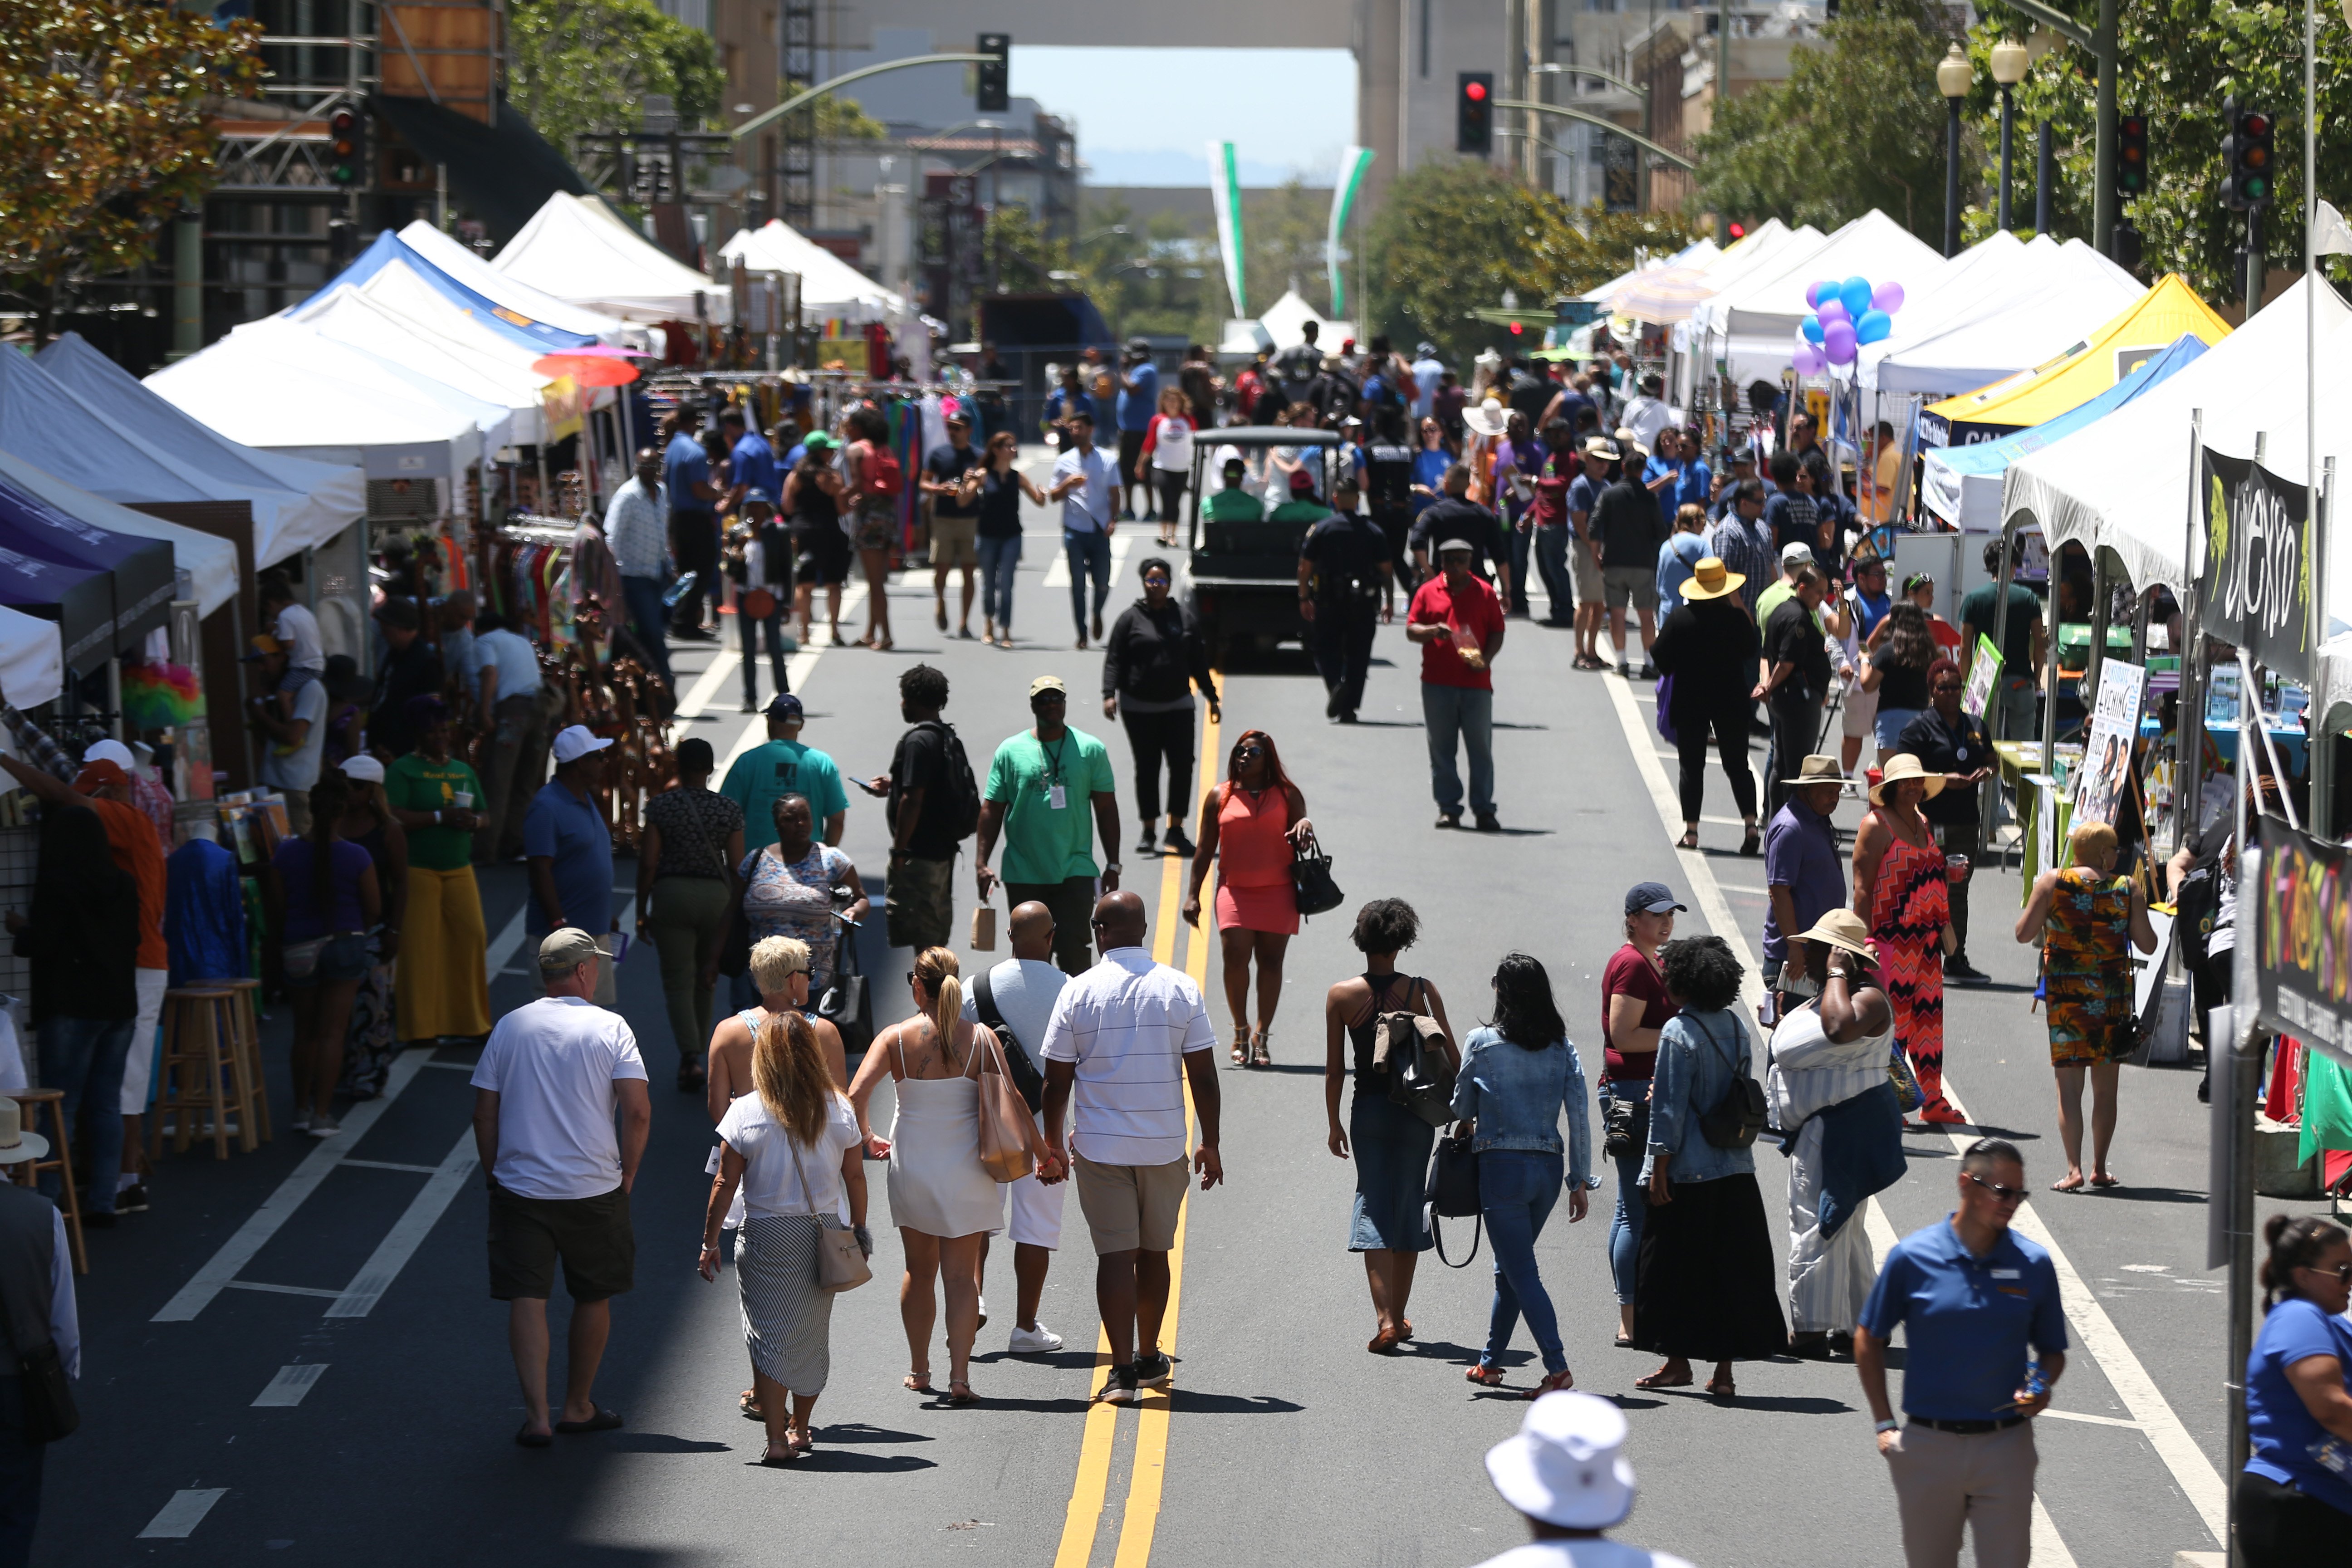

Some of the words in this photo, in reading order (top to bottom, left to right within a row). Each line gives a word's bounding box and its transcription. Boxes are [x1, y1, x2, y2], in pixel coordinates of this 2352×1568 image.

[2109, 664, 2130, 687] INTIMATE
[2098, 680, 2131, 720] EVENING
[2126, 685, 2139, 723] 2019
[2095, 732, 2105, 756] 03
